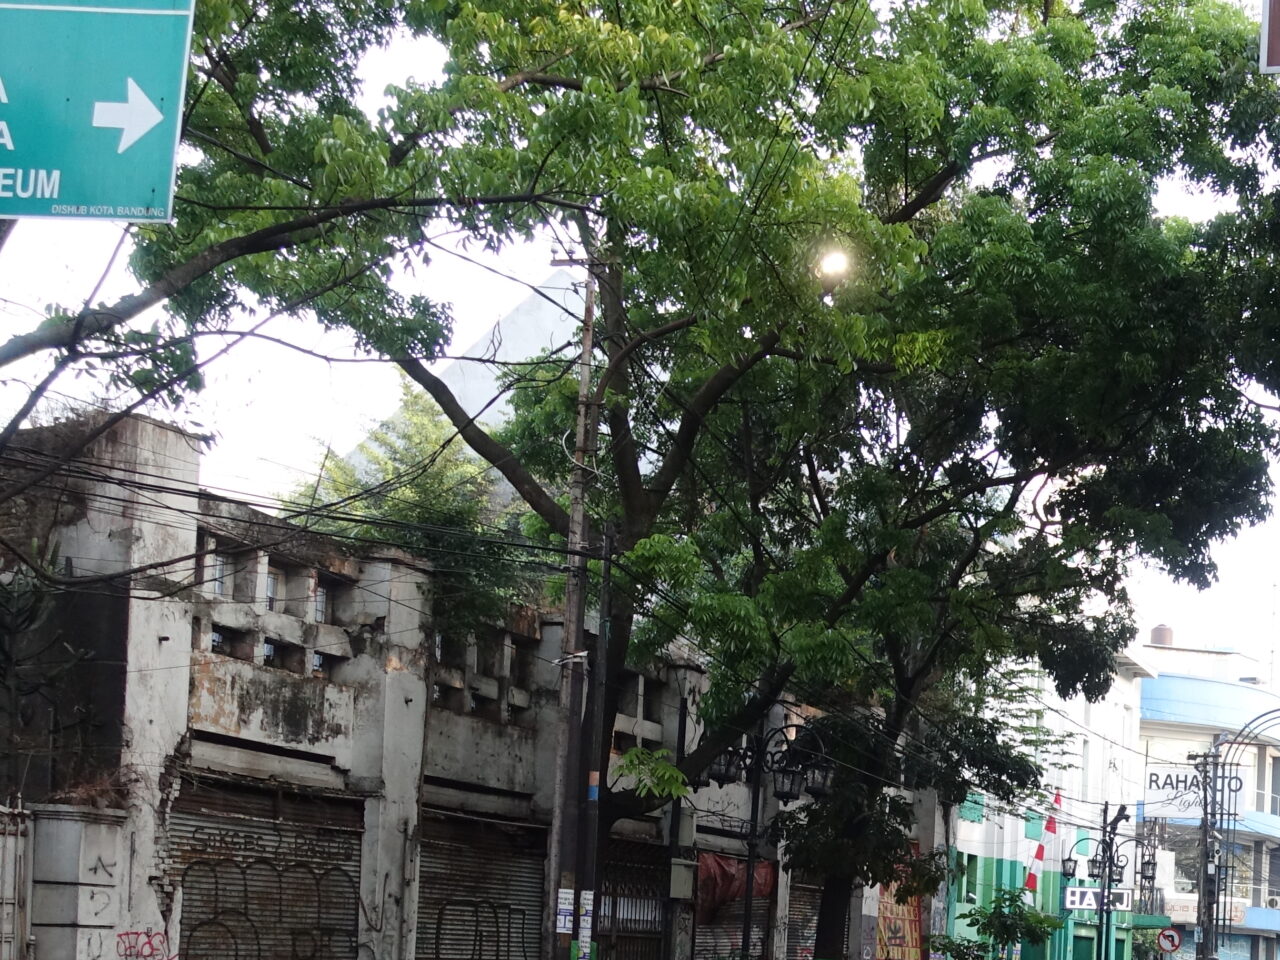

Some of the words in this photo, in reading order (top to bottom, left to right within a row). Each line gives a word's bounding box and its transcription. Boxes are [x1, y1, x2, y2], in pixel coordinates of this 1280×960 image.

[52, 205, 87, 215] DISHUB
[90, 206, 114, 215] KOTA
[117, 206, 165, 217] BANDUNG
